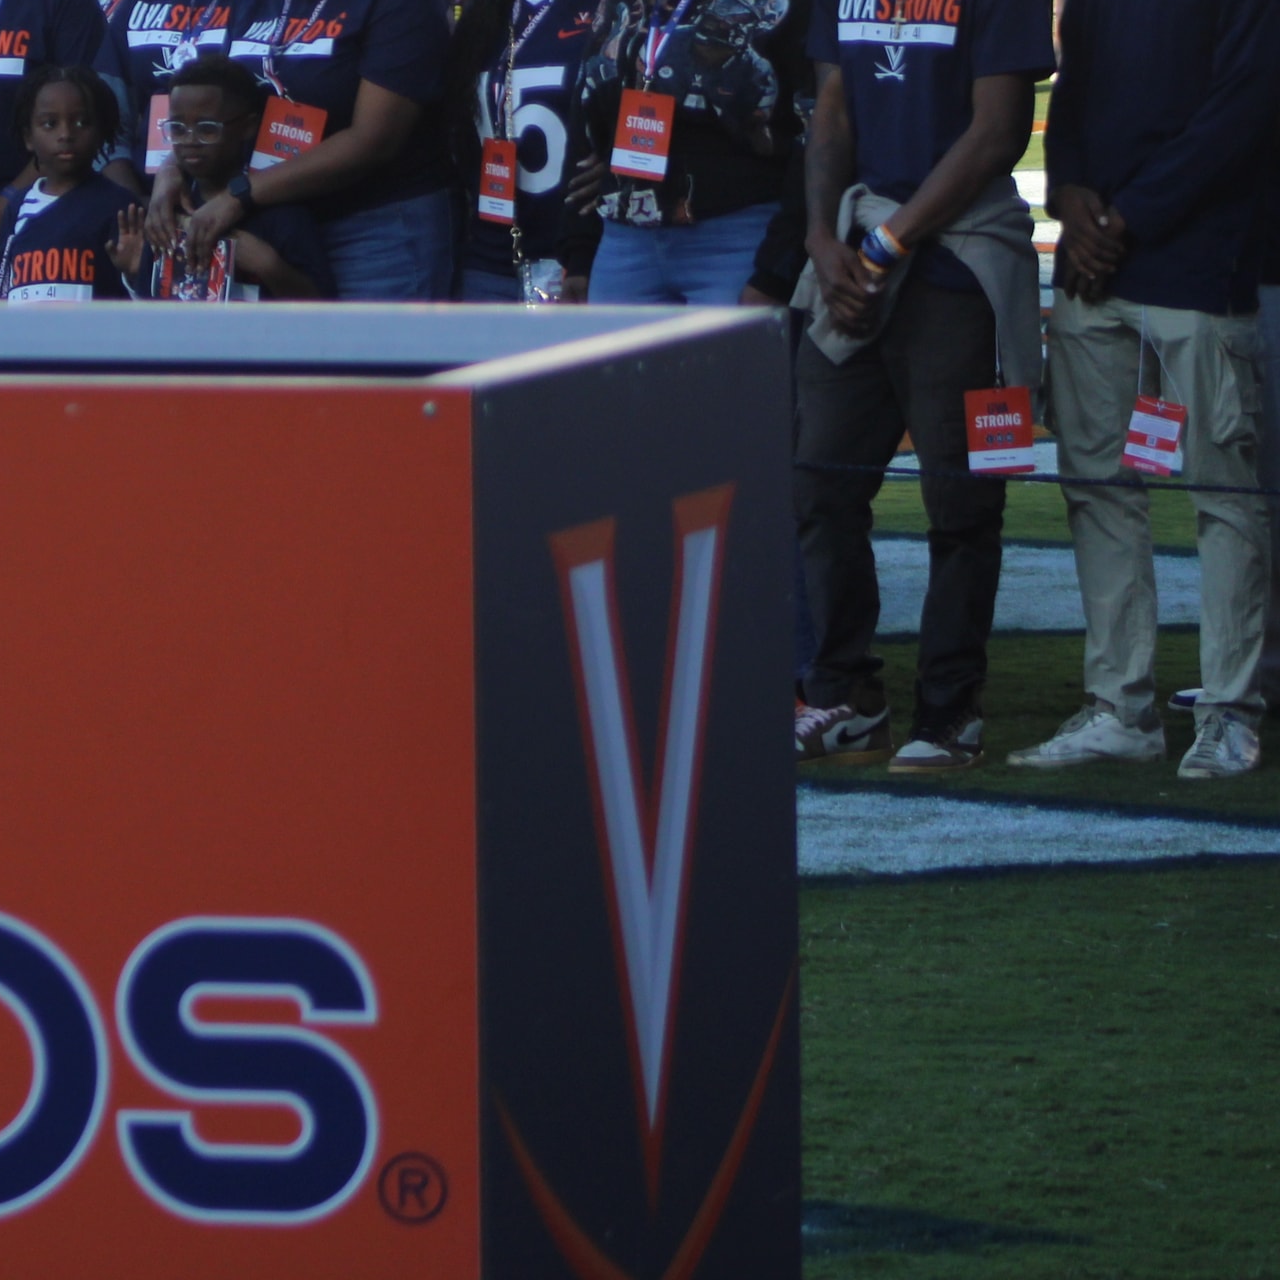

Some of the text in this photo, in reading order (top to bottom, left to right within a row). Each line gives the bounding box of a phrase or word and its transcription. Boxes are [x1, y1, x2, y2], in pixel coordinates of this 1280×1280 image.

[270, 122, 313, 145] STRONG
[625, 115, 665, 134] STRONG
[485, 163, 510, 180] STRONG
[974, 411, 1022, 429] STRONG
